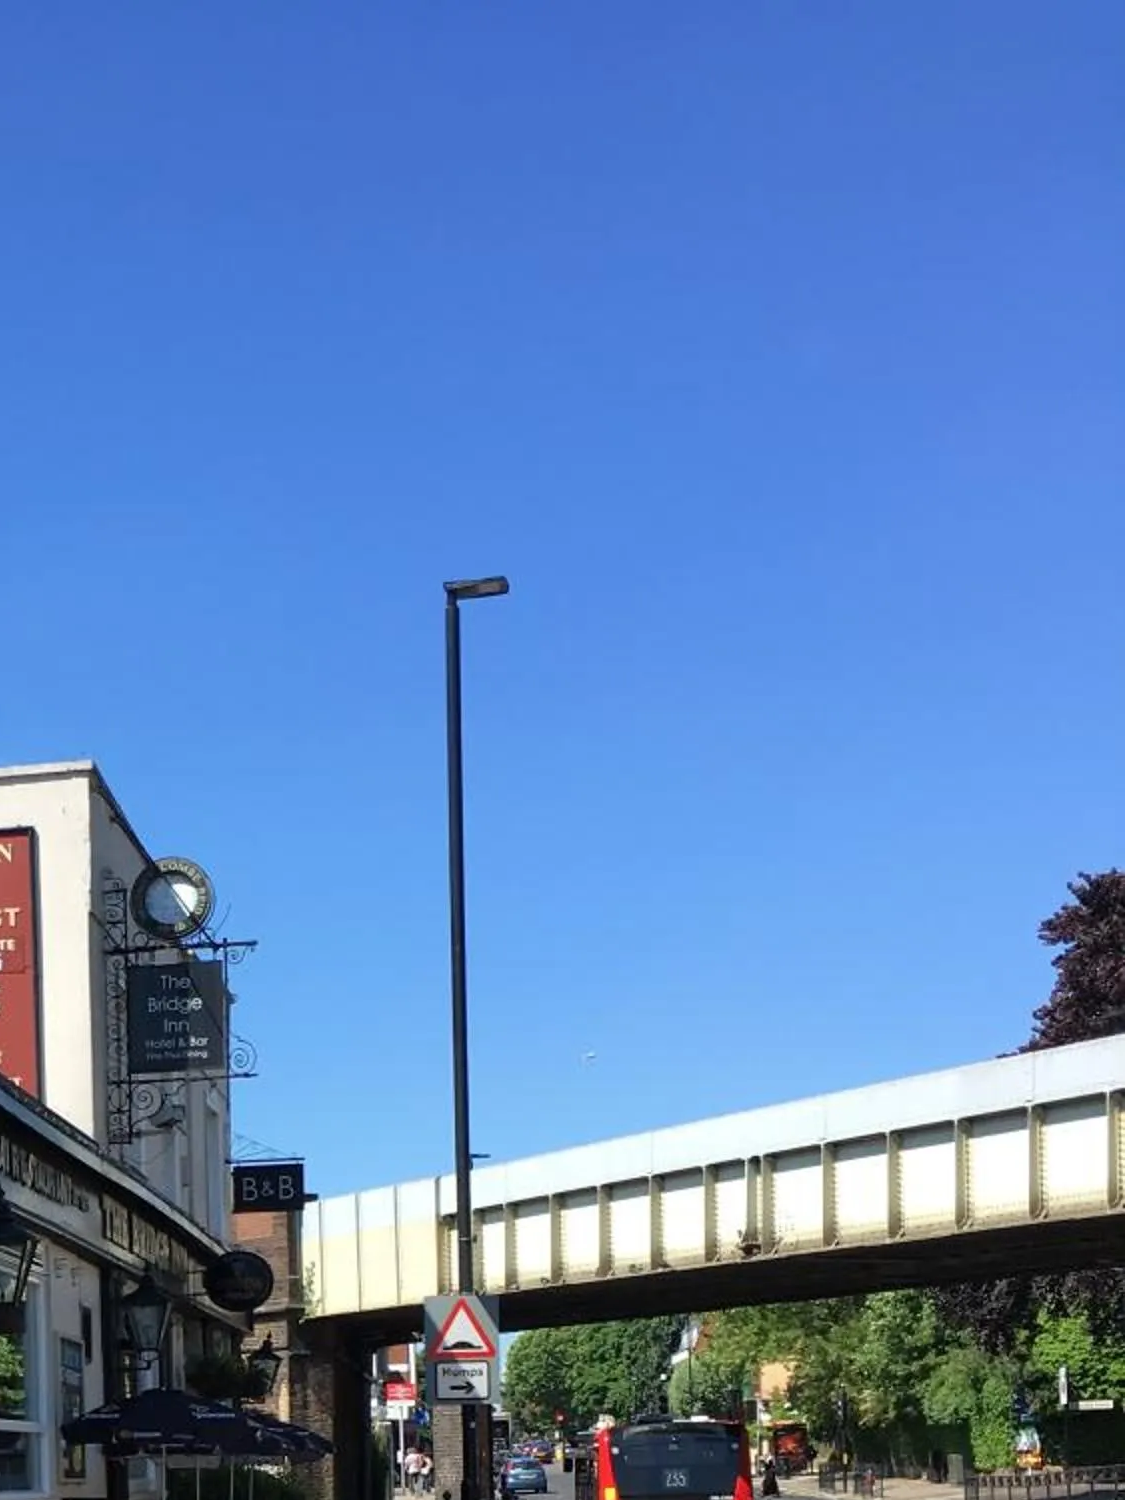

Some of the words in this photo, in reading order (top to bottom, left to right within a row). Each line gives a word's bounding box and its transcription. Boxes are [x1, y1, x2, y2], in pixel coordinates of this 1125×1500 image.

[159, 975, 191, 990] The
[147, 995, 204, 1015] Bridge
[163, 1018, 191, 1033] Inn
[189, 1035, 210, 1047] Bar
[241, 1174, 296, 1201] B&B
[441, 1367, 483, 1378] Humps
